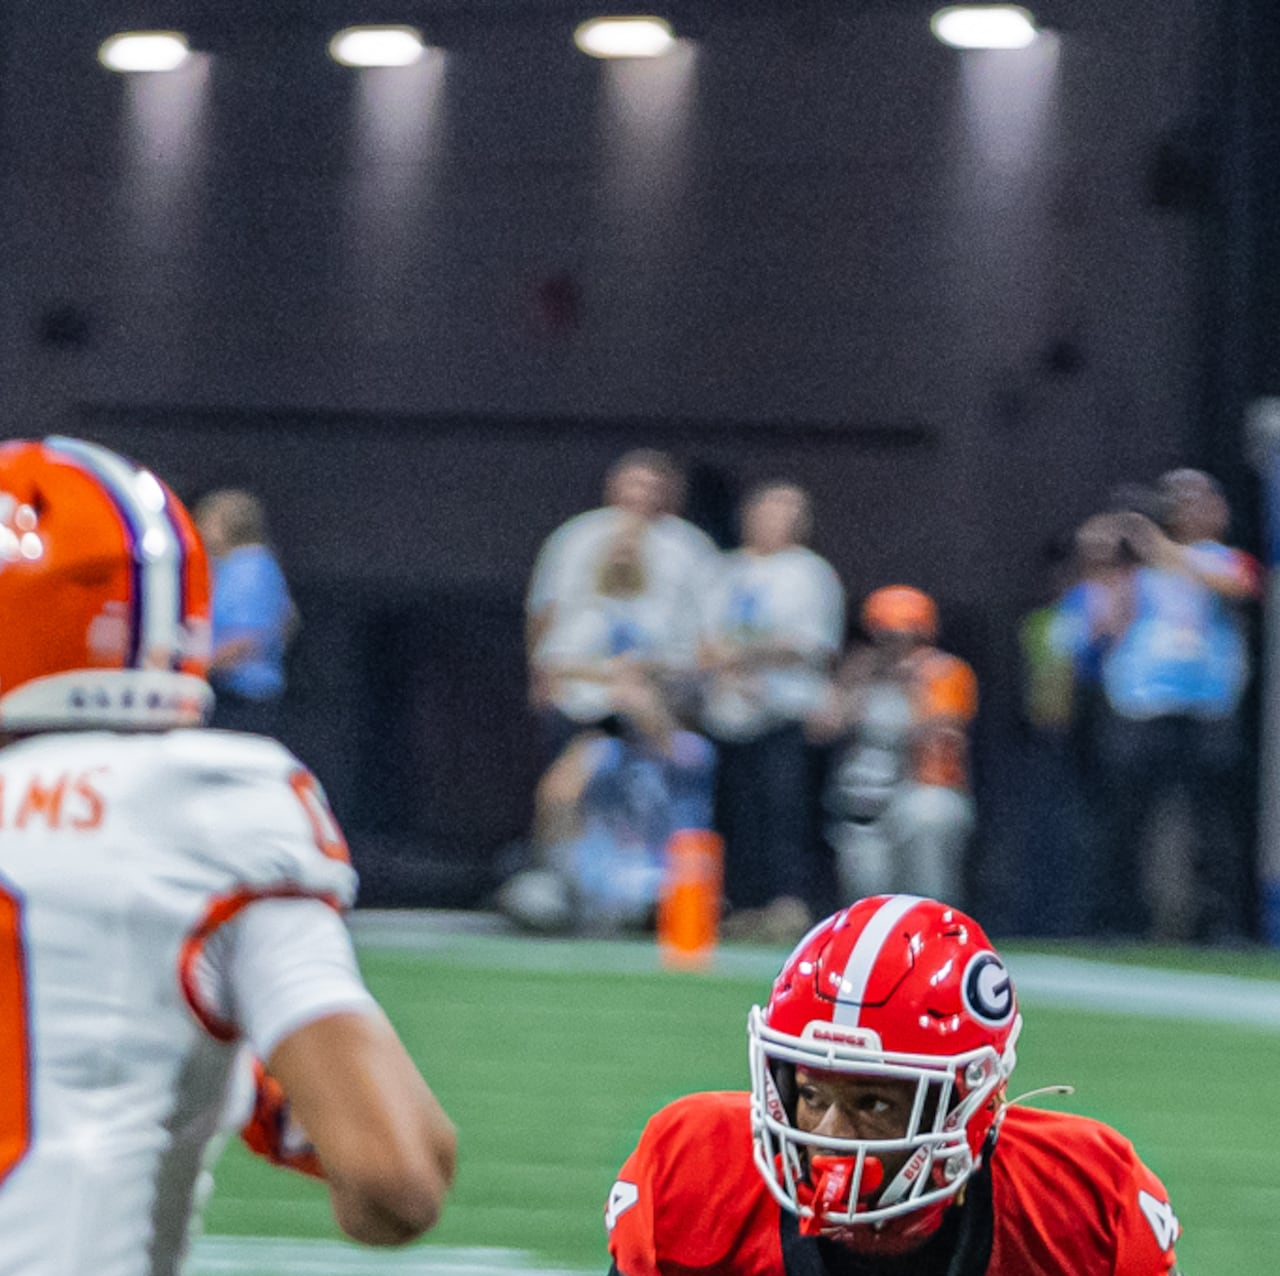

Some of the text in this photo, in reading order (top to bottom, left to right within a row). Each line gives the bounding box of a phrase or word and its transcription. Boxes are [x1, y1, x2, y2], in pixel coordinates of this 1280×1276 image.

[966, 954, 1015, 1022] G
[604, 1179, 640, 1232] 4
[1137, 1189, 1180, 1252] 4
